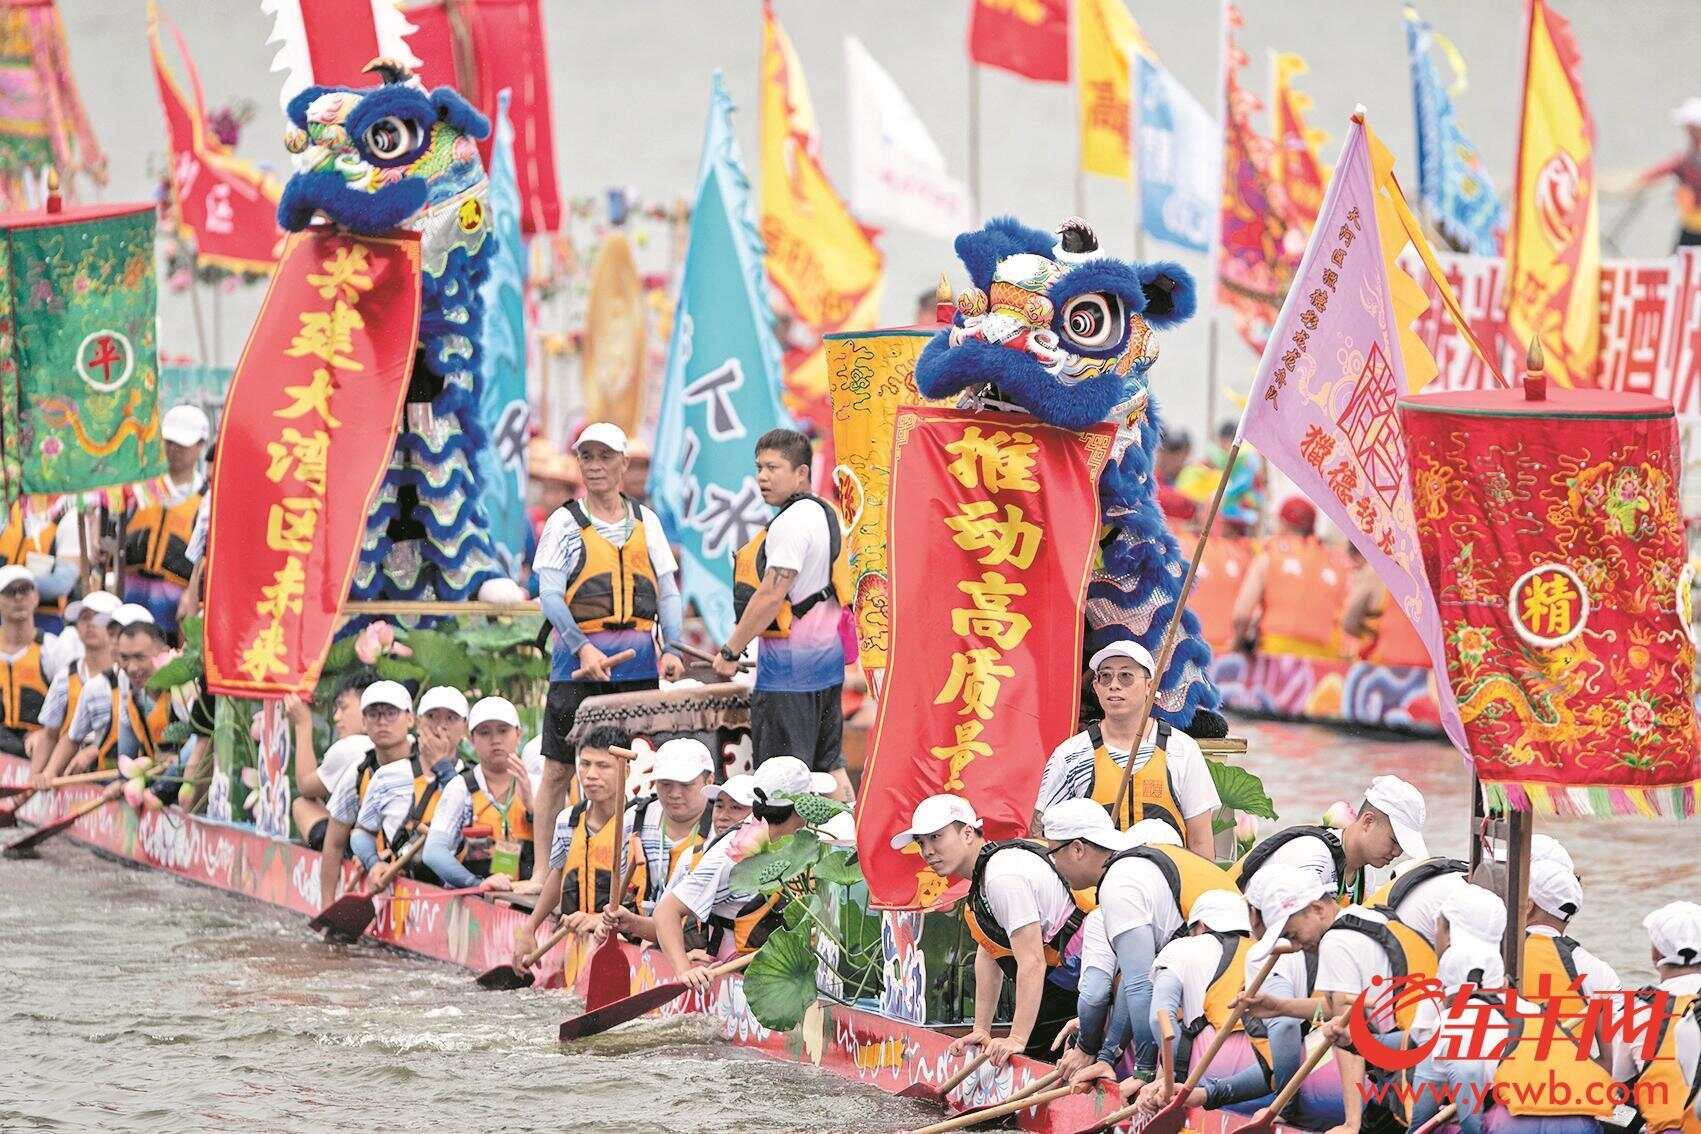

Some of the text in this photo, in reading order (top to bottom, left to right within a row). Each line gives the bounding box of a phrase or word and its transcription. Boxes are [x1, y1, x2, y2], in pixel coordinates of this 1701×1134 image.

[88, 335, 121, 385] 平
[238, 244, 374, 682] 共建大湾区未来
[901, 426, 1044, 908] 推动高质量
[1520, 573, 1577, 635] 精
